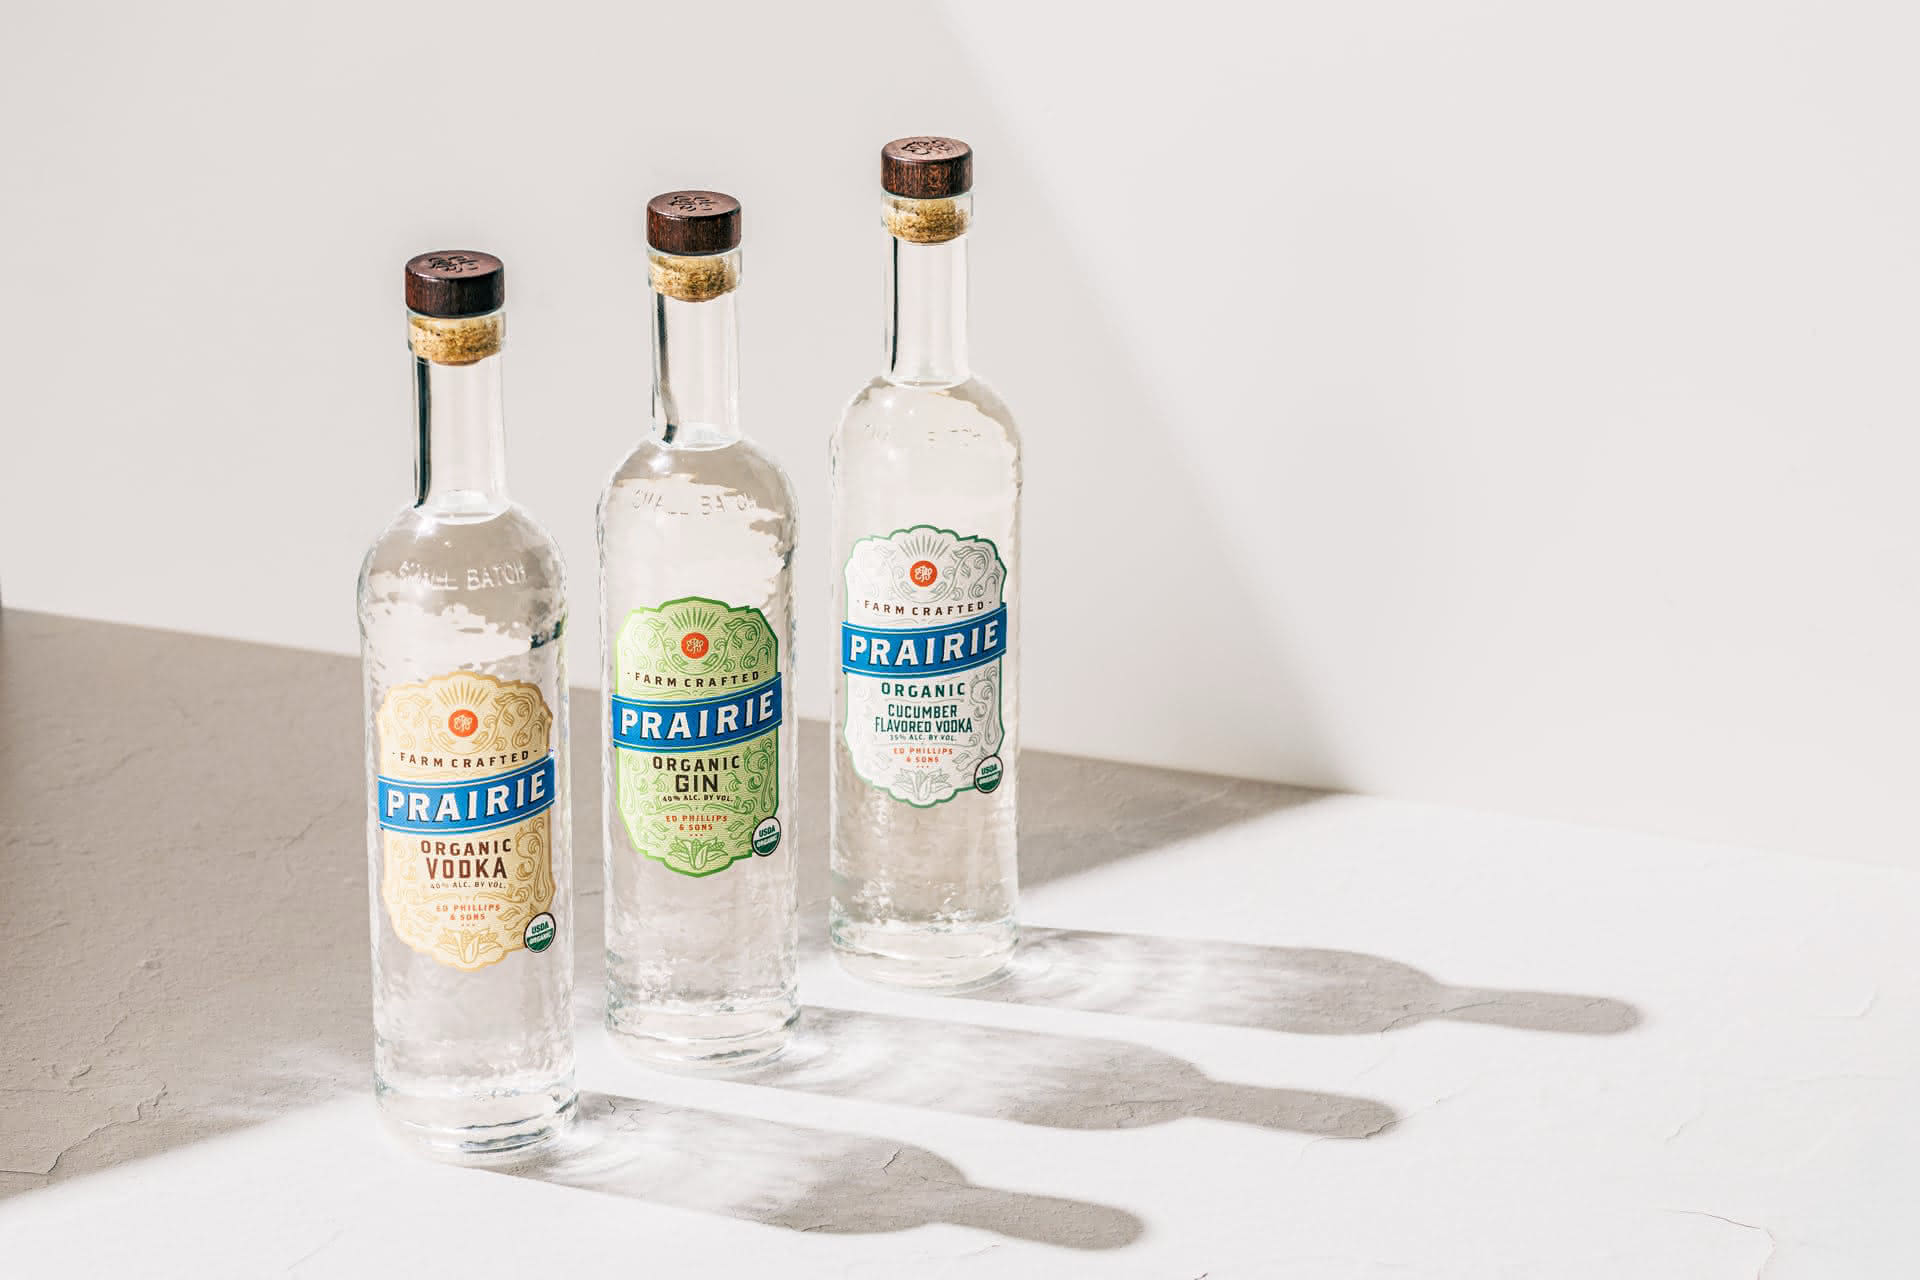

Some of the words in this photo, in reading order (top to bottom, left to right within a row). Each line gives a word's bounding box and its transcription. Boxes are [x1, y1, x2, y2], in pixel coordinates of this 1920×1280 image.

[466, 560, 527, 591] BATCH
[864, 600, 905, 615] FARM
[912, 601, 984, 616] CRAFTED
[848, 619, 1000, 667] PRAIRIE
[635, 673, 677, 687] FARM
[684, 671, 759, 687] CRAFTED
[881, 682, 966, 698] ORGANIC
[620, 689, 775, 740] PRAIRIE
[888, 703, 957, 719] CUCUMBER
[875, 716, 931, 733] FLAVORED
[936, 717, 973, 733] VODKA
[400, 752, 443, 768] FARM
[451, 750, 528, 768] CRAFTED
[909, 747, 953, 755] PHILLIPS
[653, 755, 741, 772] ORGANIC
[675, 774, 719, 793] GIN
[387, 769, 546, 823] PRAIRIE
[759, 824, 776, 837] USDA
[421, 838, 512, 856] ORGANIC
[426, 857, 508, 879] VODKA
[454, 904, 500, 912] PHILLIPS
[531, 921, 550, 934] USDA
